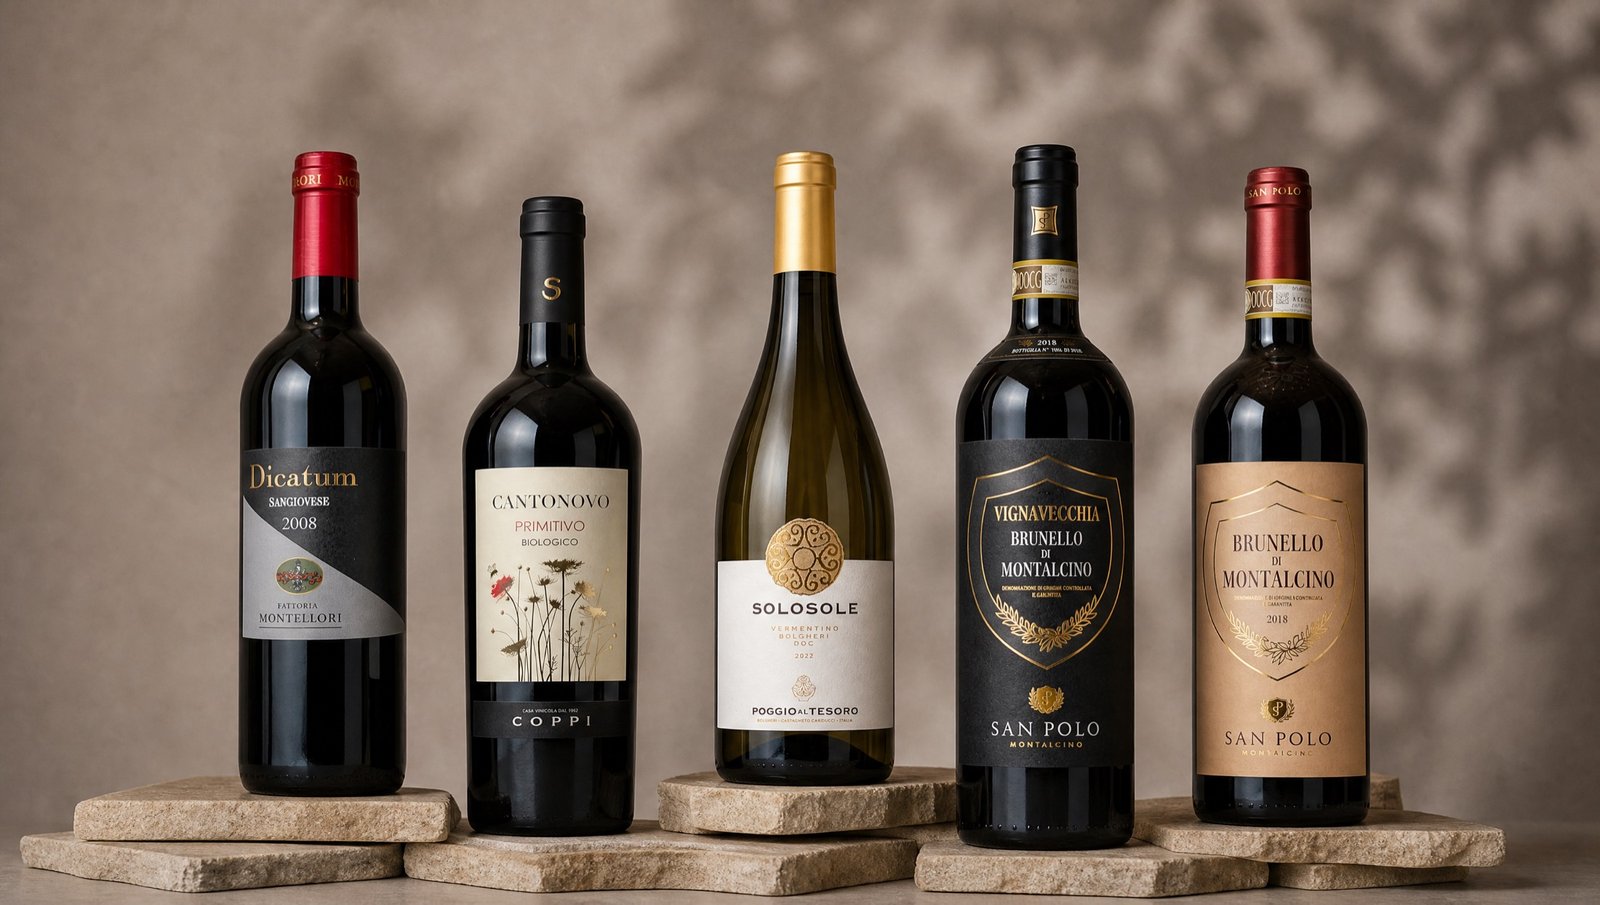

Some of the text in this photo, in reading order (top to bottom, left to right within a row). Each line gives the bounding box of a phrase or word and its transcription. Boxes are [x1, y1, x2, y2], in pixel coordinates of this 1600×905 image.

[1248, 186, 1301, 198] SAN POLO
[542, 277, 561, 301] S
[250, 464, 358, 489] Dicatum
[268, 496, 330, 507] SANGIOVESE
[492, 494, 610, 510] CANTONOVO
[994, 505, 1100, 522] VIGNAVECCHIA
[282, 517, 317, 530] 2008
[515, 520, 585, 532] PRIMITIVO
[521, 538, 579, 547] BIOLOGICO
[1011, 531, 1083, 546] BRUNELLO
[1233, 534, 1323, 552] BRUNELLO
[1041, 549, 1051, 559] DI
[1272, 556, 1282, 566] DI
[1001, 562, 1092, 577] MONTALCINO
[1223, 570, 1335, 589] MONTALCINO
[277, 602, 318, 610] FATTORIA
[752, 602, 858, 615] SOLOSOLE
[259, 613, 342, 623] MONTELLORI
[1266, 614, 1288, 624] 2018
[752, 707, 797, 716] POGGIO
[809, 707, 859, 716] TESORO
[512, 716, 591, 727] COPPI
[991, 721, 1100, 737] SAN POLO
[1225, 731, 1332, 746] SAN POLO
